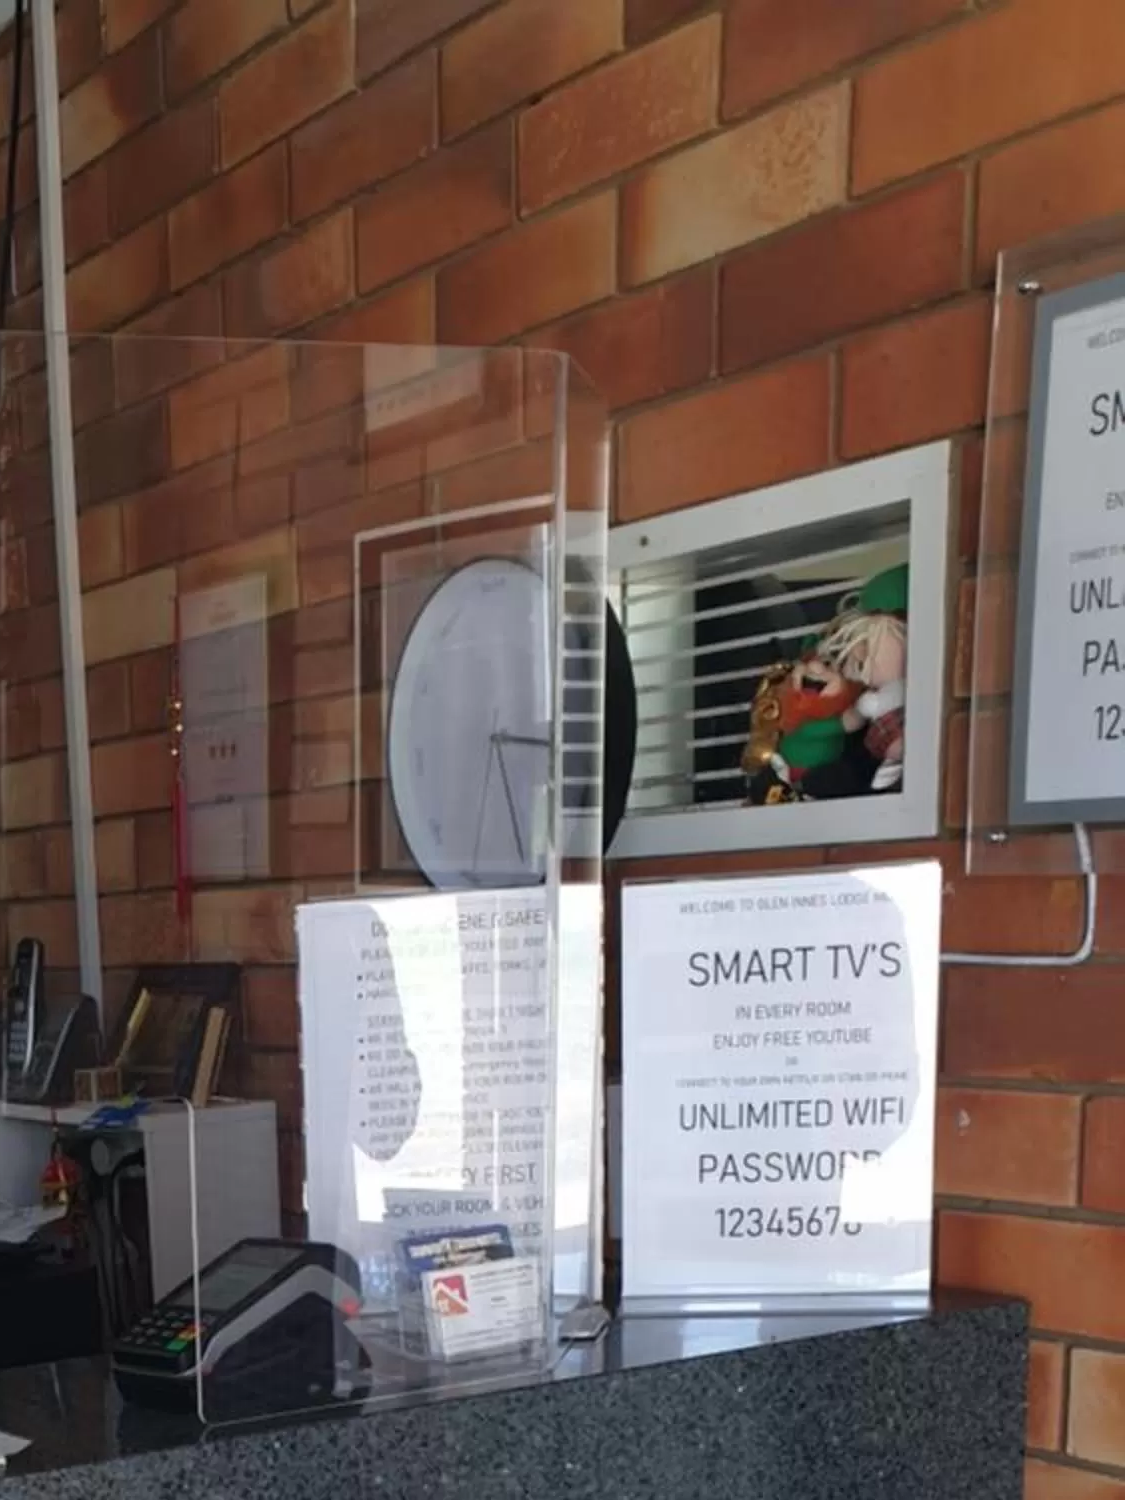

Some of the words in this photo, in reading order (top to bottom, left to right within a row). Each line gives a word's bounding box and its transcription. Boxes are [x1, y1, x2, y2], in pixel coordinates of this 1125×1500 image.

[1082, 638, 1125, 677] PA
[1094, 703, 1125, 741] 12
[688, 945, 816, 987] SMART
[825, 941, 903, 980] TV'S
[735, 1004, 752, 1020] IN
[754, 1002, 801, 1020] EVERY
[806, 1000, 852, 1017] ROOM
[712, 1031, 761, 1050] ENJOY
[763, 1029, 802, 1047] FREE
[806, 1027, 873, 1046] YOUTUBE
[679, 1098, 833, 1131] UNLIMITED
[842, 1096, 904, 1127] WIFI
[484, 1162, 537, 1185] FRST
